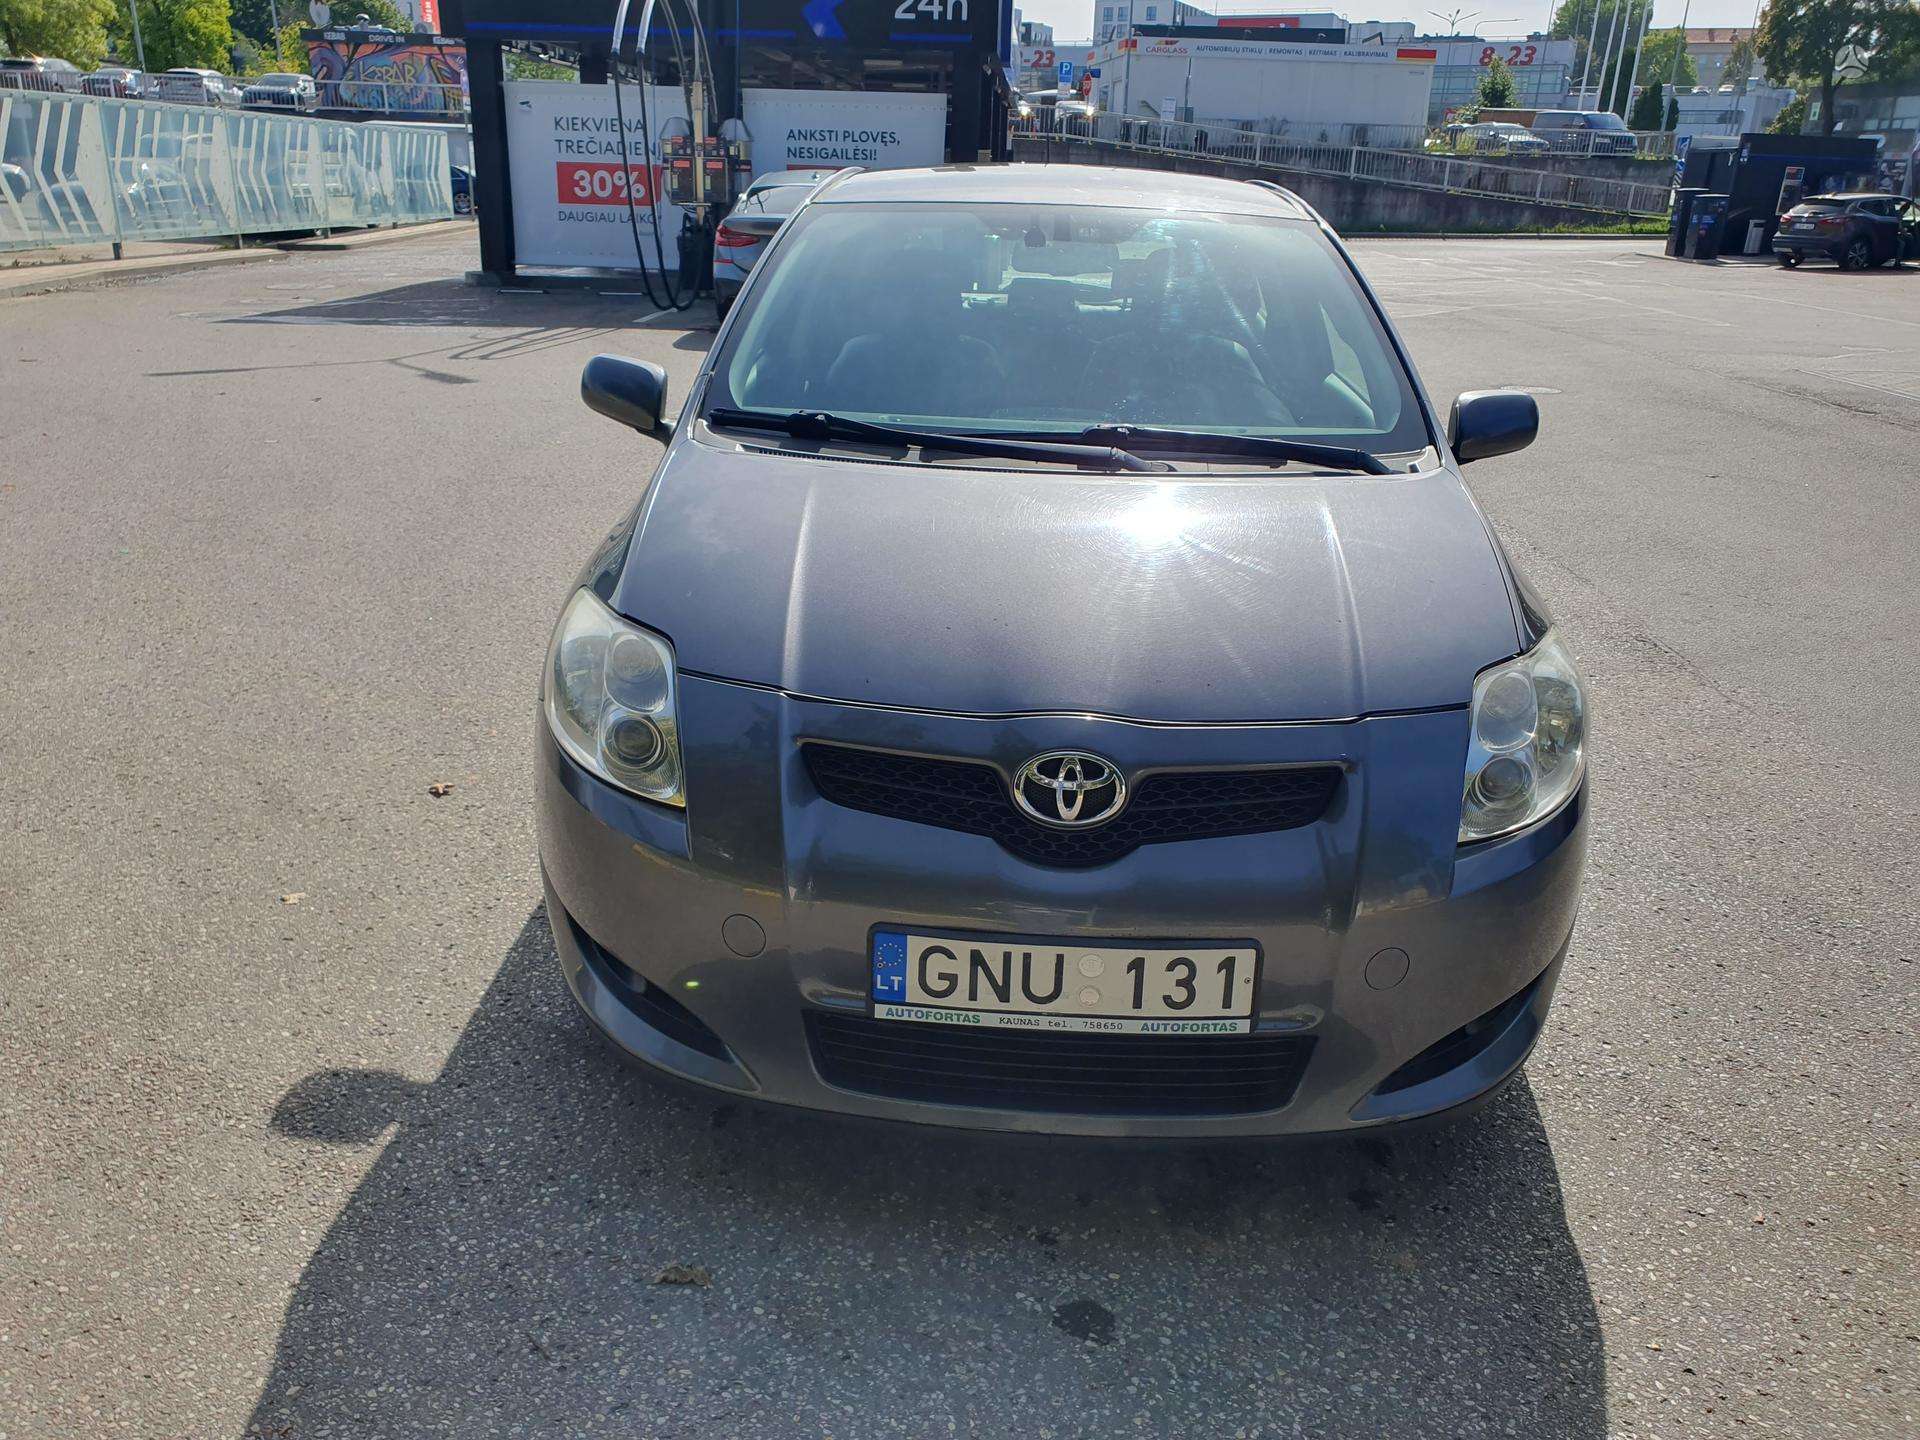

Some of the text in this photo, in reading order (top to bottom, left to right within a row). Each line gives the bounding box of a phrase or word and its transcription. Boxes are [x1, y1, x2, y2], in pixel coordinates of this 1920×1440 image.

[368, 34, 405, 43] DRIVE IN
[1145, 46, 1188, 54] CARGLASS
[1063, 63, 1070, 74] P
[786, 129, 838, 142] ANKSTI
[573, 170, 646, 199] 30%
[558, 210, 616, 222] DAUGIAU
[876, 975, 902, 991] LT
[918, 945, 1236, 1010] GNU 131
[885, 1007, 1238, 1032] AUTOFORTAS KAUNAS tel. 758650 AUTOFORTAS
